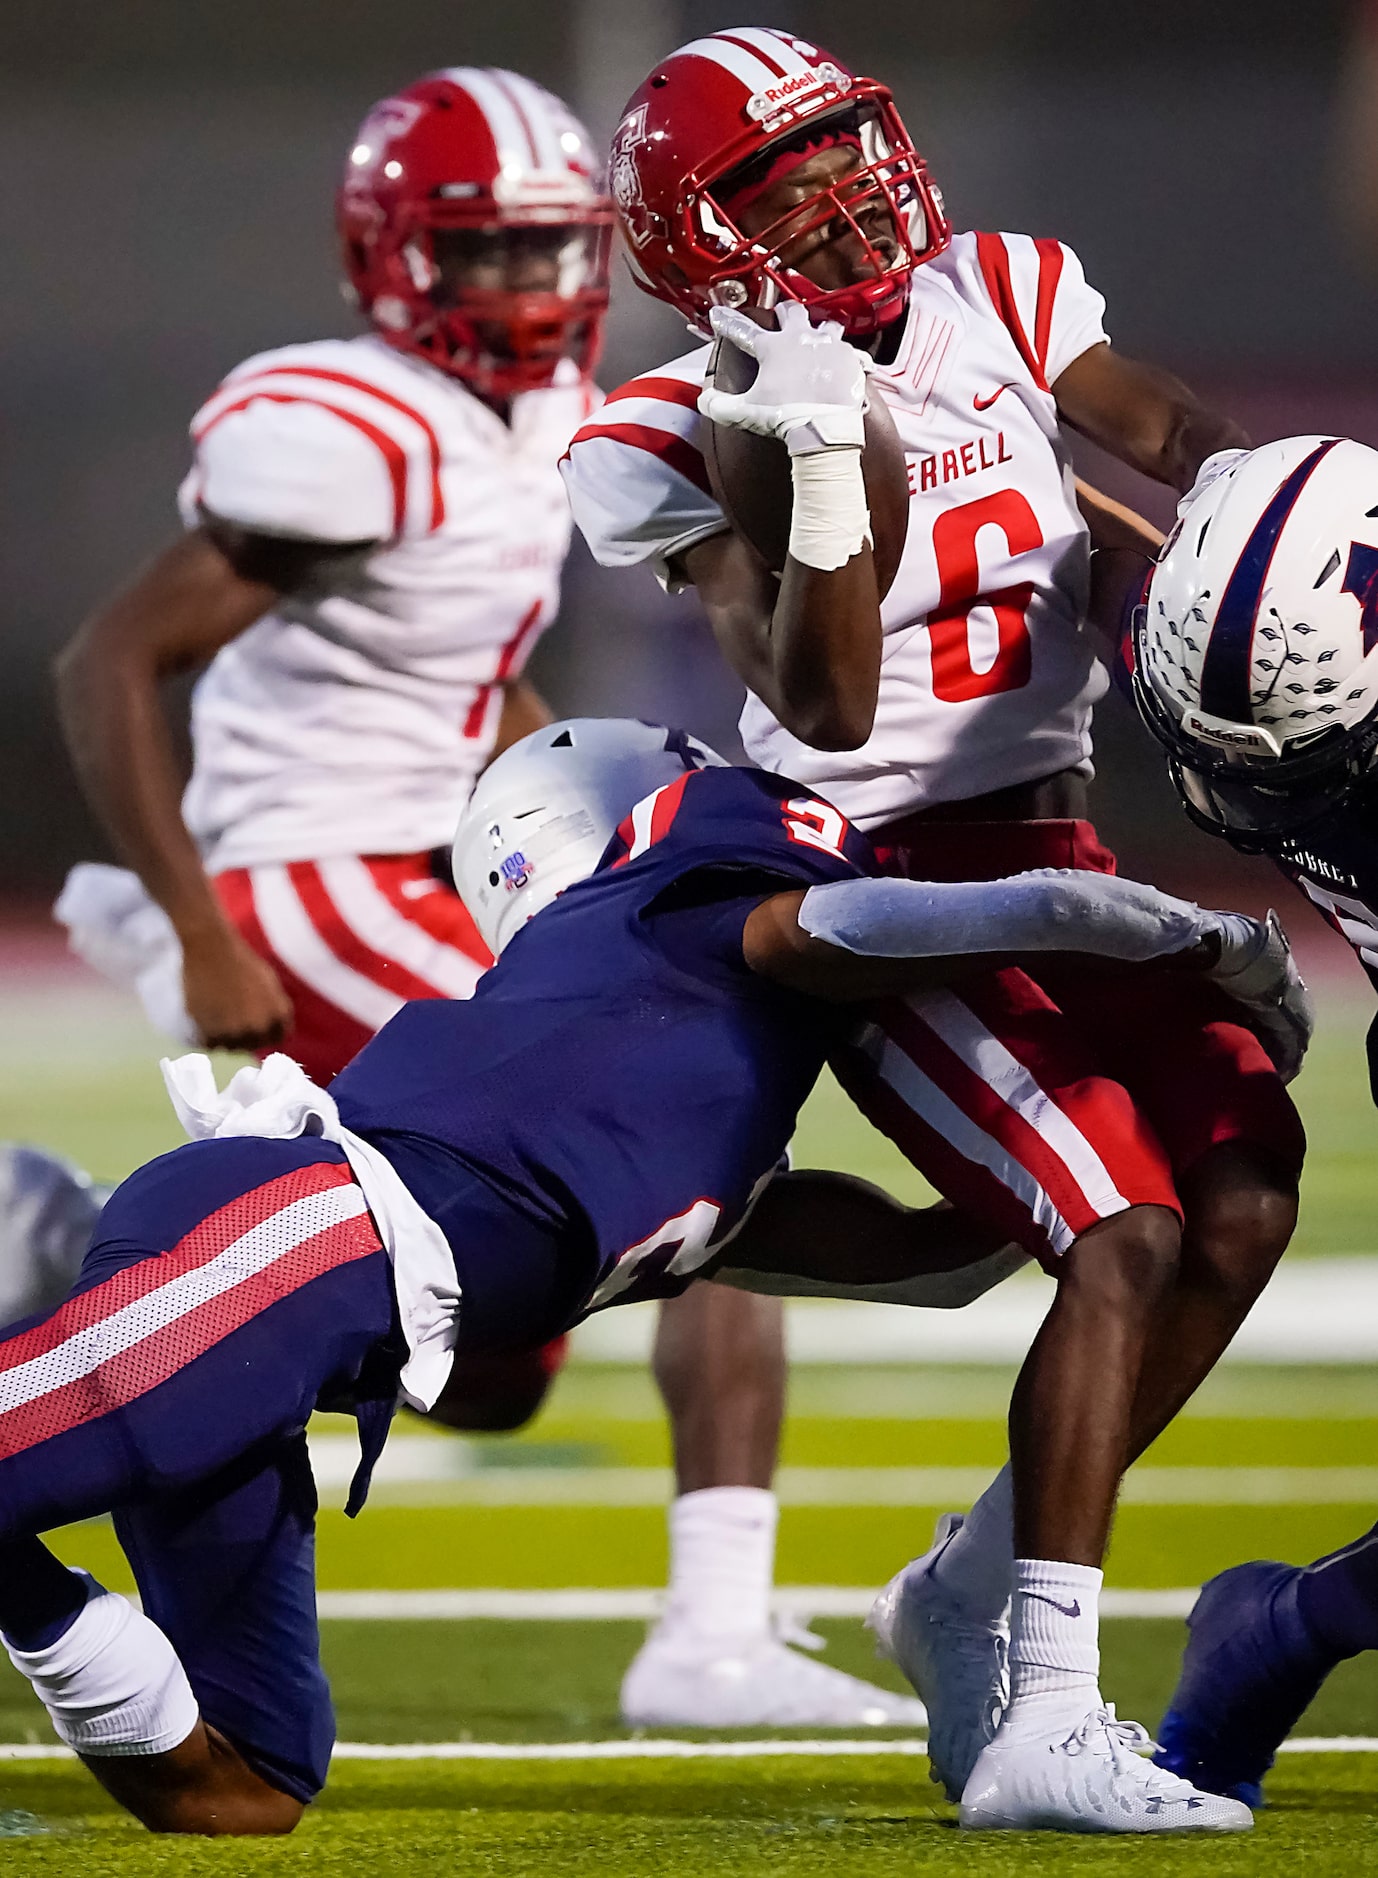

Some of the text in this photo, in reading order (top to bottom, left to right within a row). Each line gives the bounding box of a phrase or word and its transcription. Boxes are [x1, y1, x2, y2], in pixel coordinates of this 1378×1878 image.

[765, 71, 817, 103] Riddell
[907, 432, 1013, 496] ERRELL
[928, 488, 1043, 703] 6
[1190, 716, 1260, 747] Riddell
